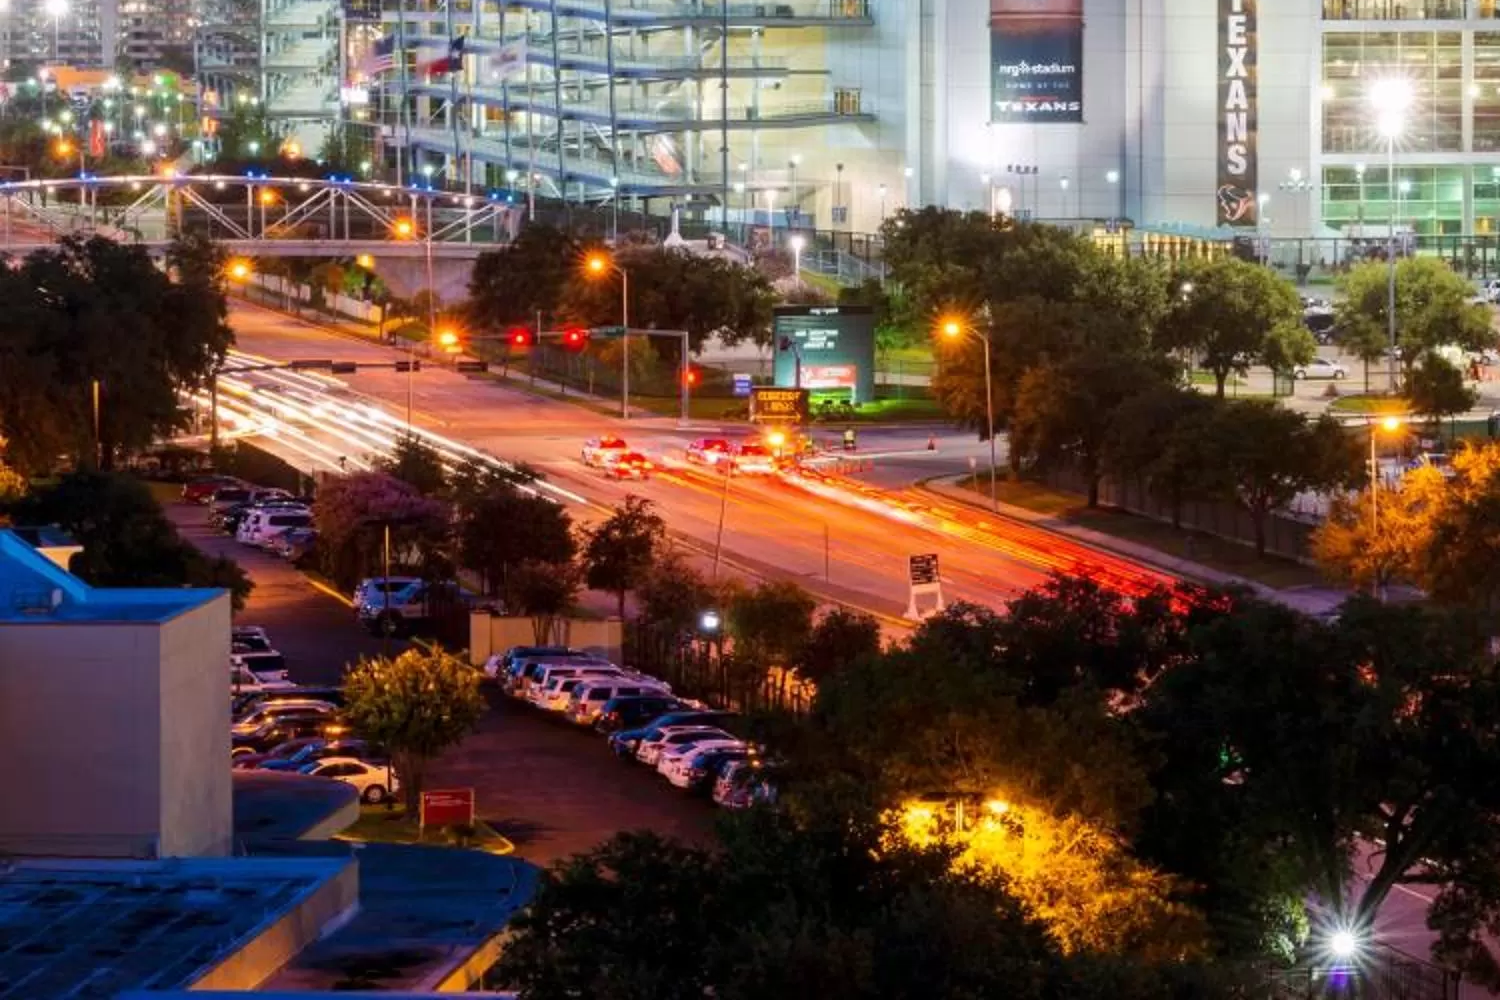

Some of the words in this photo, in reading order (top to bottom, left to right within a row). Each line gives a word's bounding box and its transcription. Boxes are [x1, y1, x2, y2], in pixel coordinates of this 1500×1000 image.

[999, 64, 1020, 76] nrg
[1031, 62, 1076, 74] stadium
[995, 101, 1081, 112] TEXANS
